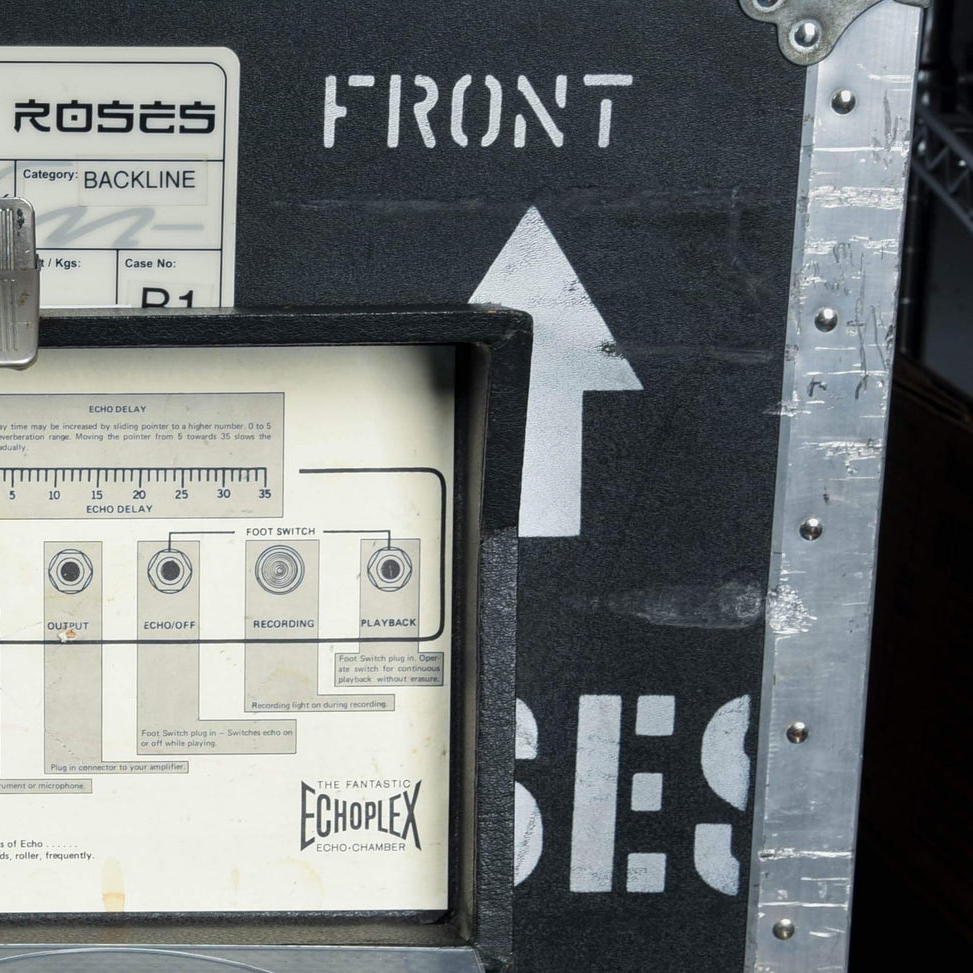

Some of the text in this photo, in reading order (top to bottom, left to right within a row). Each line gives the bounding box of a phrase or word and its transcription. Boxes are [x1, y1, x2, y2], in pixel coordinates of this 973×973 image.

[324, 74, 633, 148] FRONT
[23, 169, 195, 189] Category: BACKLINE
[125, 259, 176, 267] Case No:
[101, 423, 110, 431] by
[10, 491, 15, 499] 5
[49, 491, 60, 500] 10
[92, 490, 103, 499] 15
[133, 490, 146, 499] 20
[175, 490, 188, 499] 25
[218, 489, 230, 498] 30
[259, 489, 271, 498] 35
[118, 505, 152, 513] DELAY
[247, 527, 315, 537] FOOT SWITCH
[47, 621, 88, 631] OUTPUT
[144, 621, 195, 631] ECHO/OFF
[253, 619, 314, 629] RECORDING
[361, 618, 416, 628] PLAYBACK
[388, 655, 404, 664] plug
[338, 675, 371, 684] playback
[377, 675, 407, 683] without
[252, 701, 289, 710] Recording
[292, 701, 308, 710] light
[323, 701, 347, 709] during
[317, 780, 411, 789] THE FANTASTIC
[300, 779, 422, 851] ECHOPLEX
[8, 840, 17, 848] of
[21, 840, 43, 848] Echo
[15, 852, 42, 861] roller,
[46, 852, 94, 862] frequently.
